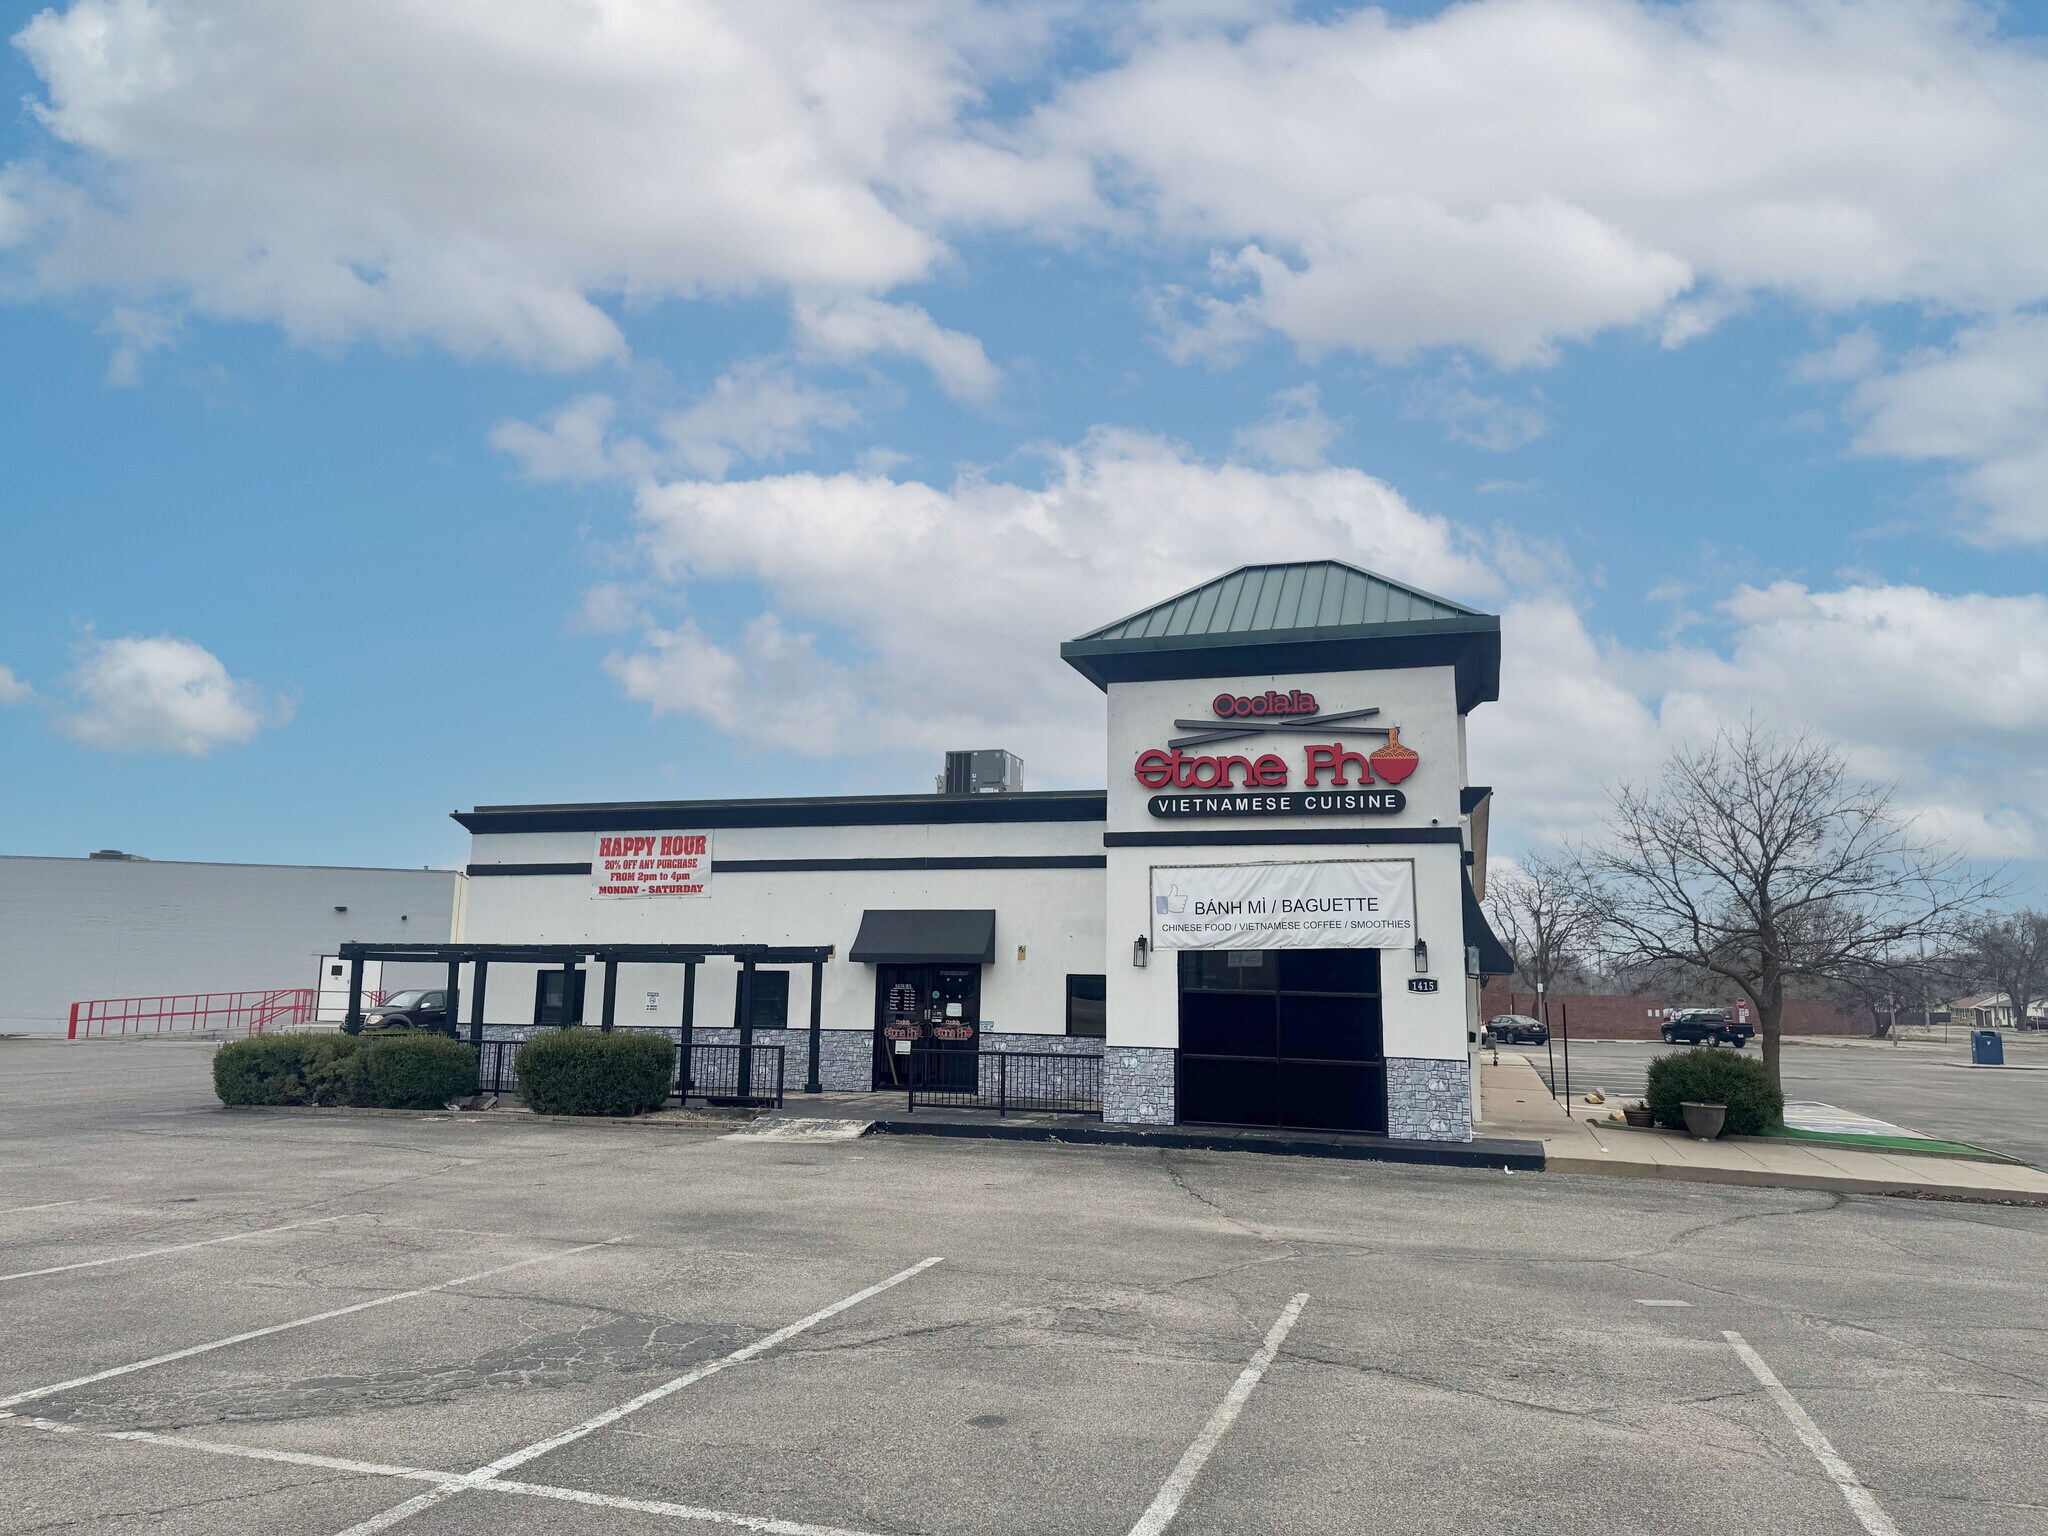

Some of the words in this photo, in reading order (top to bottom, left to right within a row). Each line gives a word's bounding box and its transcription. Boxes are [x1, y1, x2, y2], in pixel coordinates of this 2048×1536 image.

[1135, 748, 1288, 788] Stone
[1158, 797, 1291, 812] VIETNAMESE
[1304, 794, 1396, 809] CUISINE
[599, 837, 656, 857] HAPPY
[660, 835, 707, 856] HOUR
[604, 860, 621, 870] 20%
[623, 860, 637, 870] OFF
[638, 859, 655, 870] ANY
[657, 858, 698, 869] PURCHASE
[610, 872, 635, 881] FROM
[637, 872, 657, 882] 2pm
[660, 872, 668, 880] to
[671, 871, 690, 882] 4pm
[598, 885, 639, 894] MONDAY
[648, 884, 704, 894] SATURDAY
[1195, 899, 1242, 915] BÁNH
[1282, 897, 1379, 913] BAGUETTE
[1162, 923, 1202, 932] CHINESE
[1204, 922, 1232, 931] FOOD
[1239, 921, 1301, 931] VIETNAMESE
[1303, 920, 1342, 929] COFFEE
[1350, 920, 1411, 929] SMOOTHIES
[1412, 981, 1434, 991] 1415
